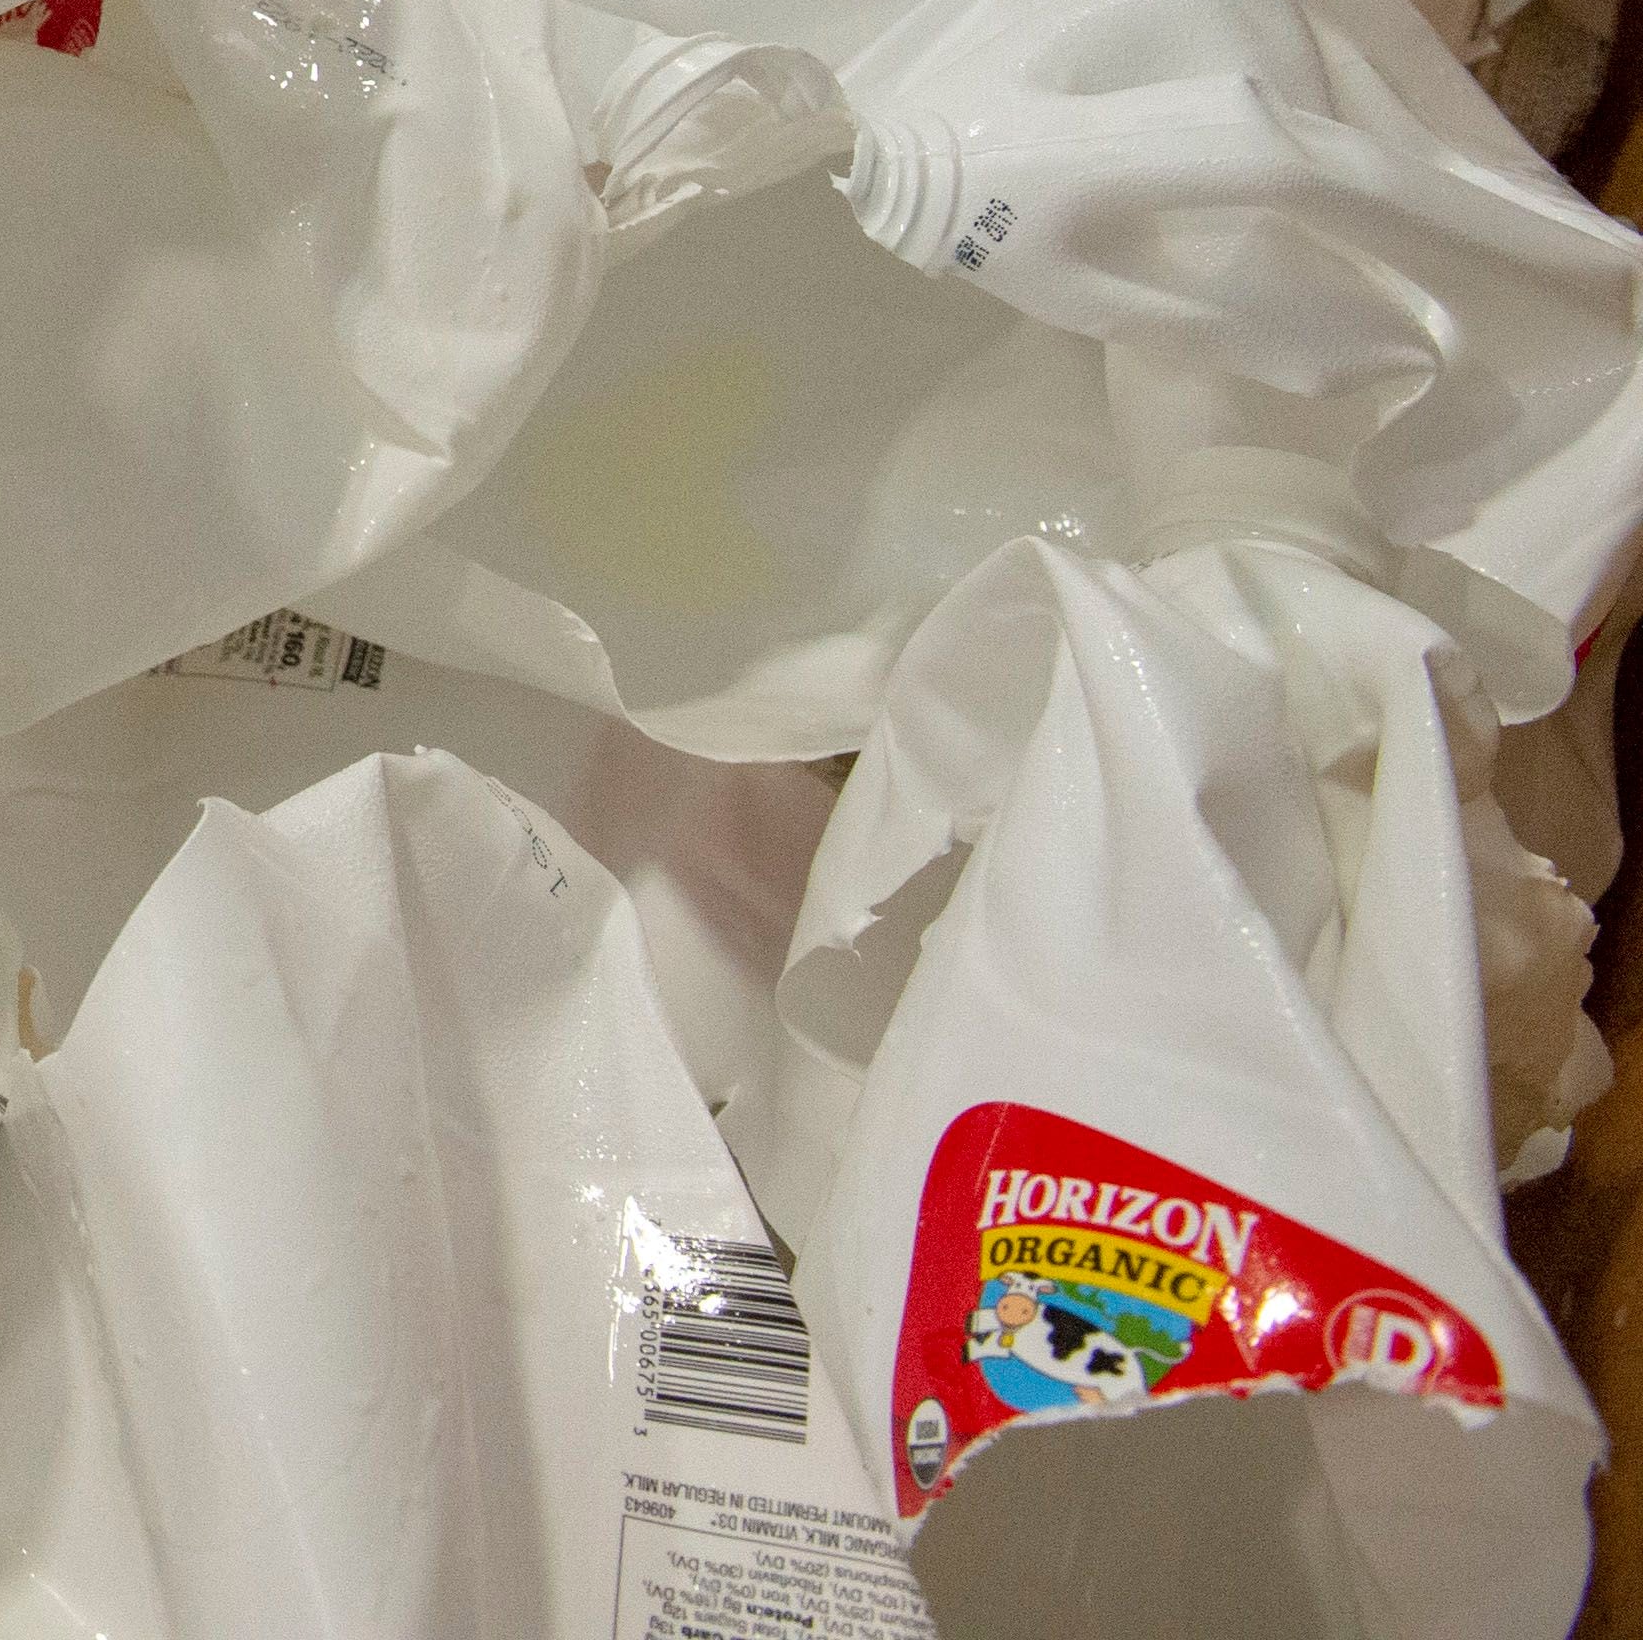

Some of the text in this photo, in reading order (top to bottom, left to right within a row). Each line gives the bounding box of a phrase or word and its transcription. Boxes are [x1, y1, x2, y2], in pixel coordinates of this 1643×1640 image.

[977, 1169, 1261, 1275] HORIZON
[989, 1233, 1211, 1304] ORGANIC
[636, 1328, 657, 1398] 00675
[660, 1480, 725, 1506] REGULAR
[727, 1492, 743, 1510] IN
[623, 1495, 676, 1519] 409643
[746, 1495, 829, 1524] PERMITTED
[741, 1516, 799, 1541] VITAMIN
[830, 1509, 892, 1534] AMOUNT
